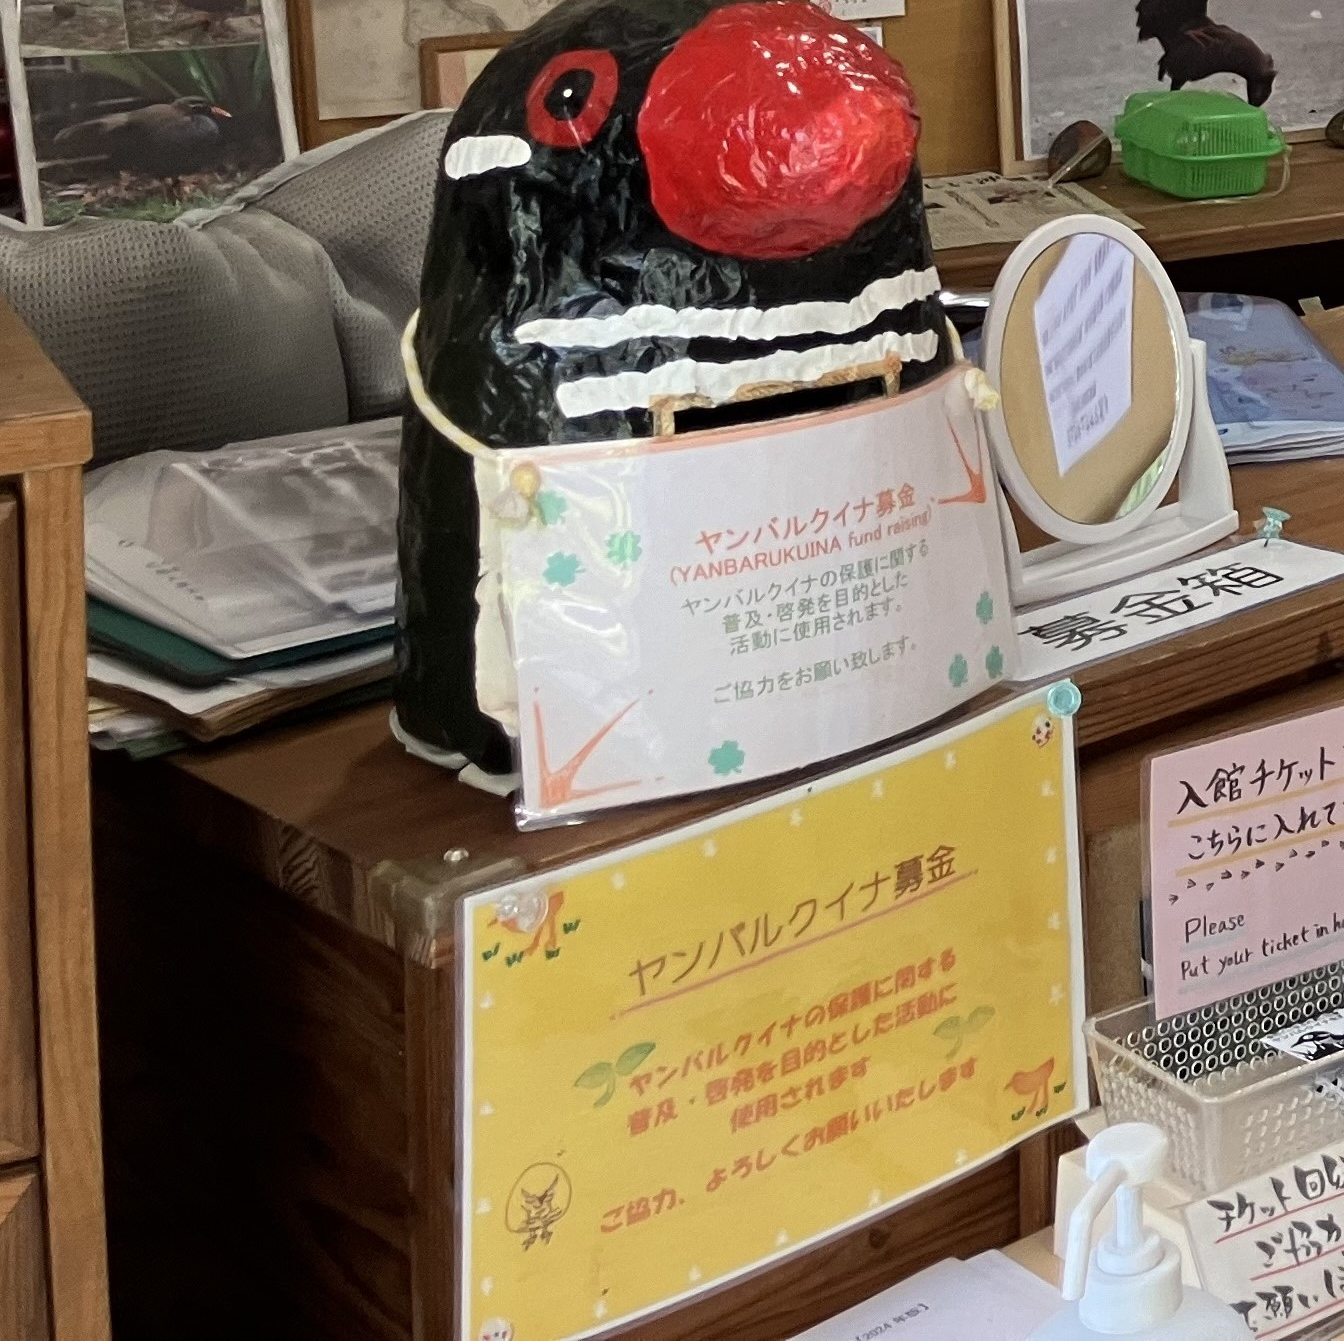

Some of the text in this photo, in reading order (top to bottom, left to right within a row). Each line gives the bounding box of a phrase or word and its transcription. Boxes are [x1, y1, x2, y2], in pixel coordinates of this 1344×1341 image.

[670, 504, 932, 586] (YANBARUKUINA fund raising)
[695, 482, 915, 555] ヤンバルクイナ募金
[681, 537, 929, 617] ヤンバルクイナの保護に関する
[722, 572, 908, 634] 普及・啓発を目的とした
[1015, 561, 1285, 652] 募金箱
[730, 597, 902, 656] 活動に使用されます。
[713, 634, 917, 703] ご協力をお願い致します。
[627, 844, 958, 999] ヤンバルクイナ募金
[1180, 958, 1210, 981] Put
[1218, 947, 1254, 979] your
[1260, 928, 1311, 958] ticket
[1315, 920, 1329, 937] in
[1184, 910, 1246, 943] Please
[626, 983, 960, 1138] 普及・啓発を目的とした活動に
[628, 948, 958, 1098] ヤンバルクイナの保護に関する
[730, 1056, 872, 1135] 使用されます
[600, 1057, 979, 1233] ご協力、 よろしくお願いいたします
[1255, 1213, 1342, 1269] ご協力
